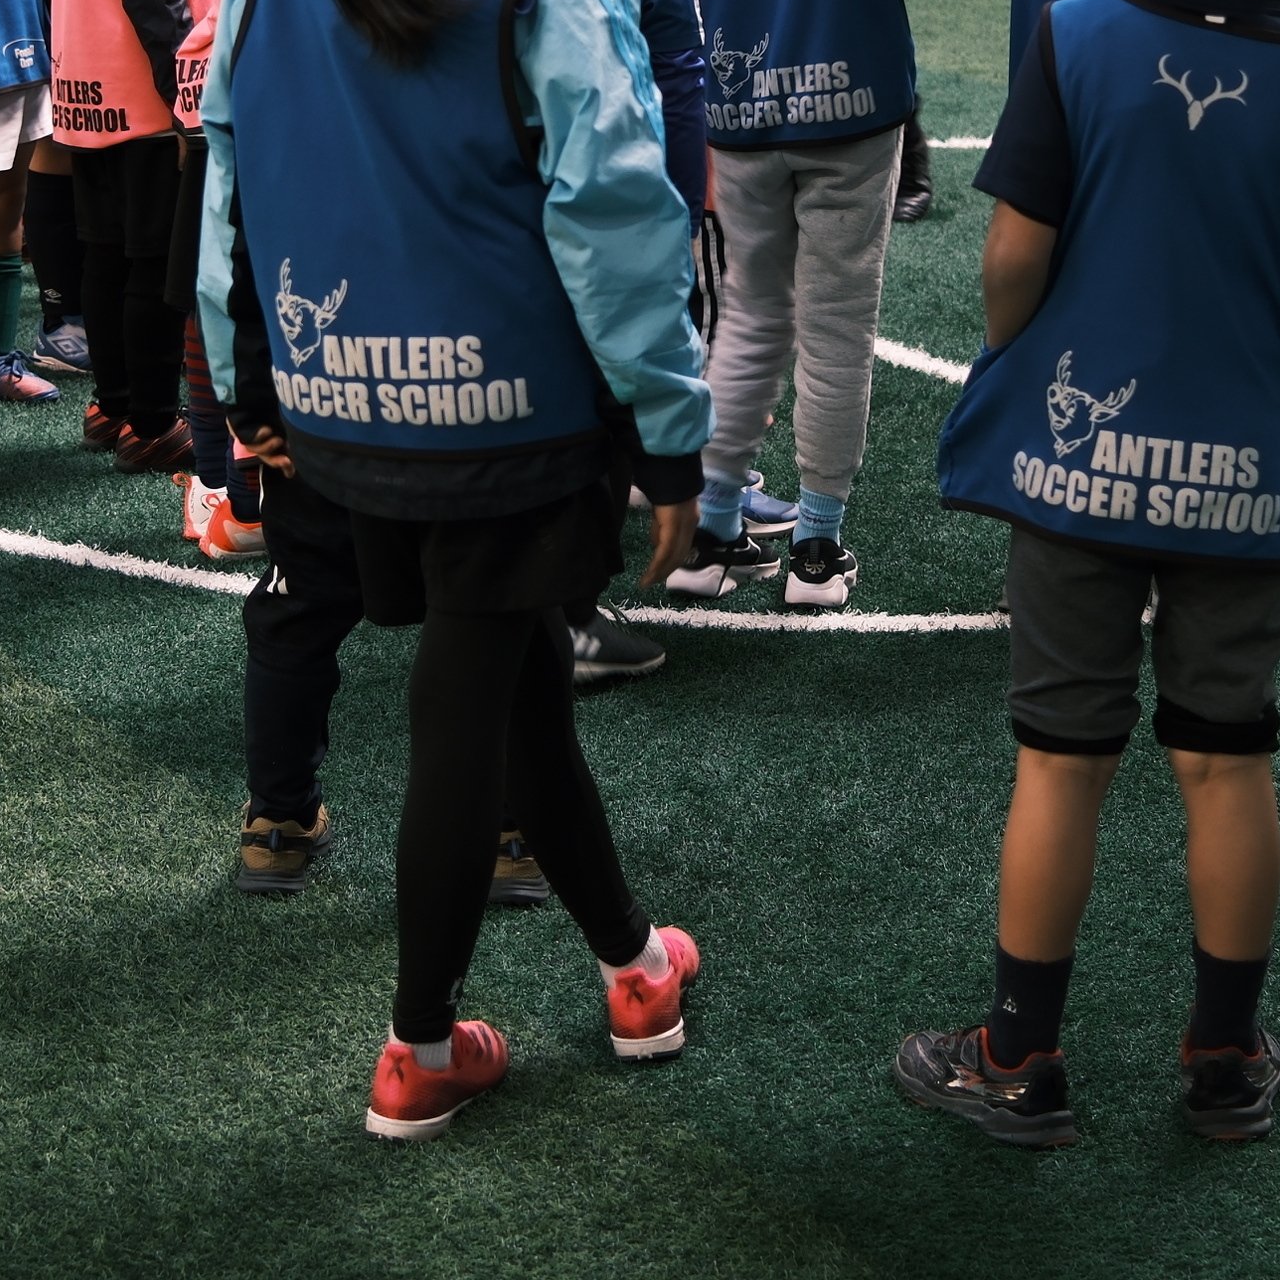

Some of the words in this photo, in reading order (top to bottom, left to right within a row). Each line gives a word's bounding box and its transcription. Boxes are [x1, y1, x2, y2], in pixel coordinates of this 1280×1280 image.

[752, 61, 851, 98] ANTLERS
[64, 107, 130, 133] SCHOOL
[323, 335, 485, 380] ANTLERS
[376, 378, 534, 426] SCHOOL
[1090, 429, 1260, 489] ANTLERS
[1012, 451, 1138, 521] SOCCER
